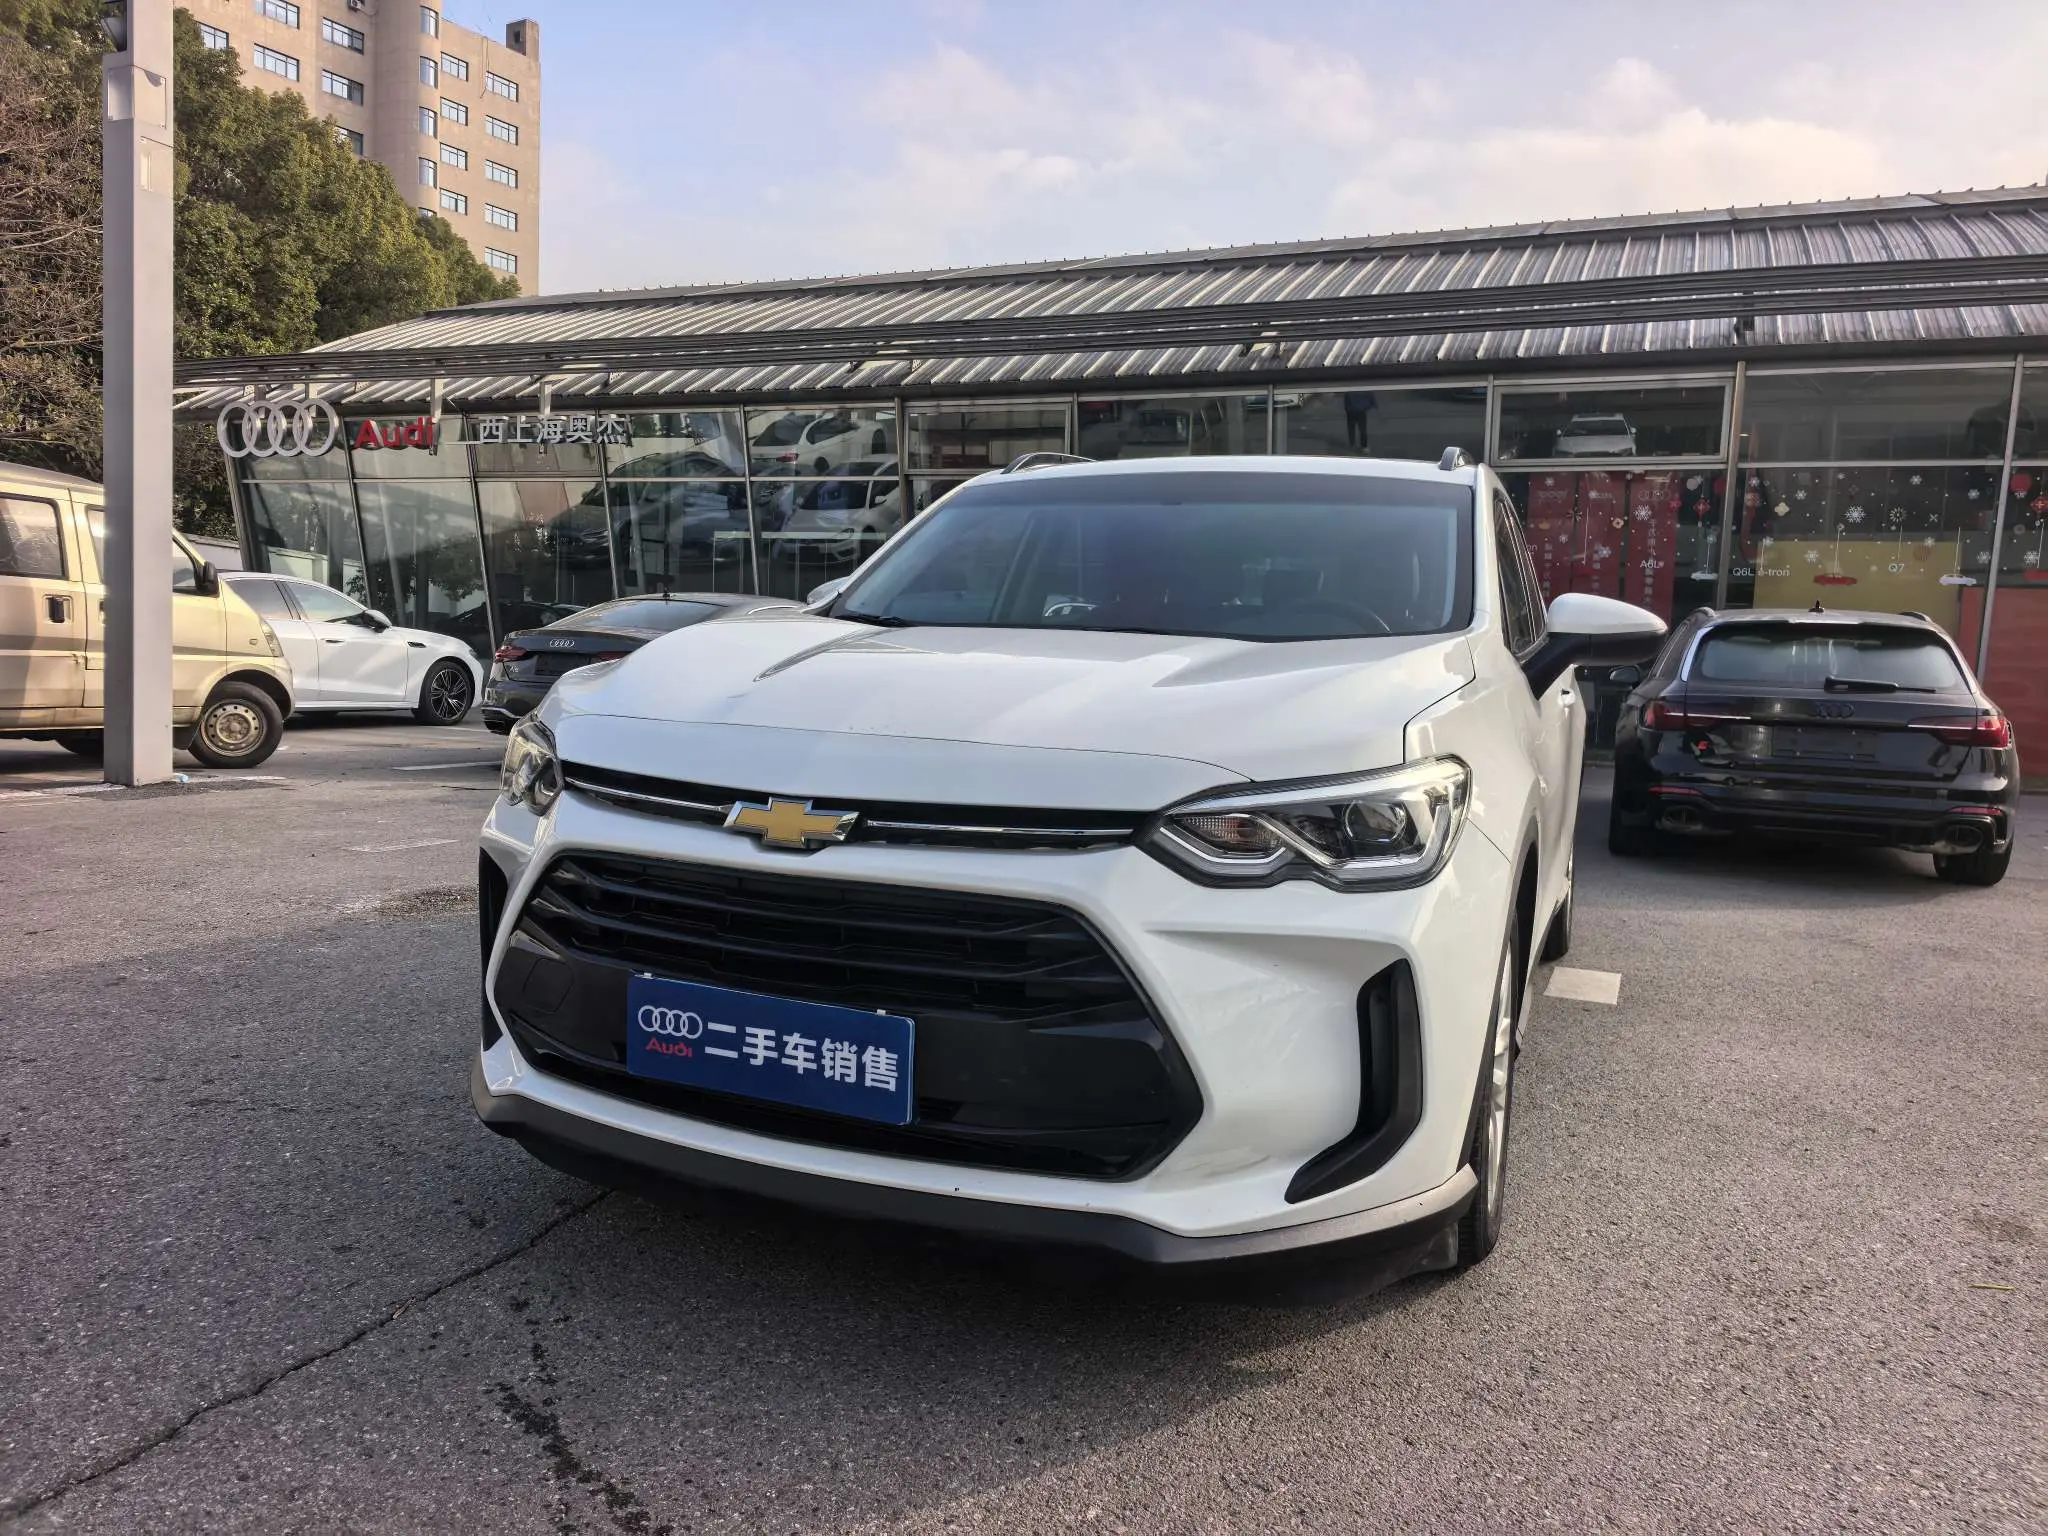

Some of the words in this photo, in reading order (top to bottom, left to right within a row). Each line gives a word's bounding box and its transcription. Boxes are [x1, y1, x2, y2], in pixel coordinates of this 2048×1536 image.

[354, 416, 435, 449] Audi
[479, 415, 628, 445] 西上海奥杰
[1888, 563, 1905, 573] Q7
[646, 1037, 693, 1058] Audi
[704, 1021, 899, 1092] 二手车销售
